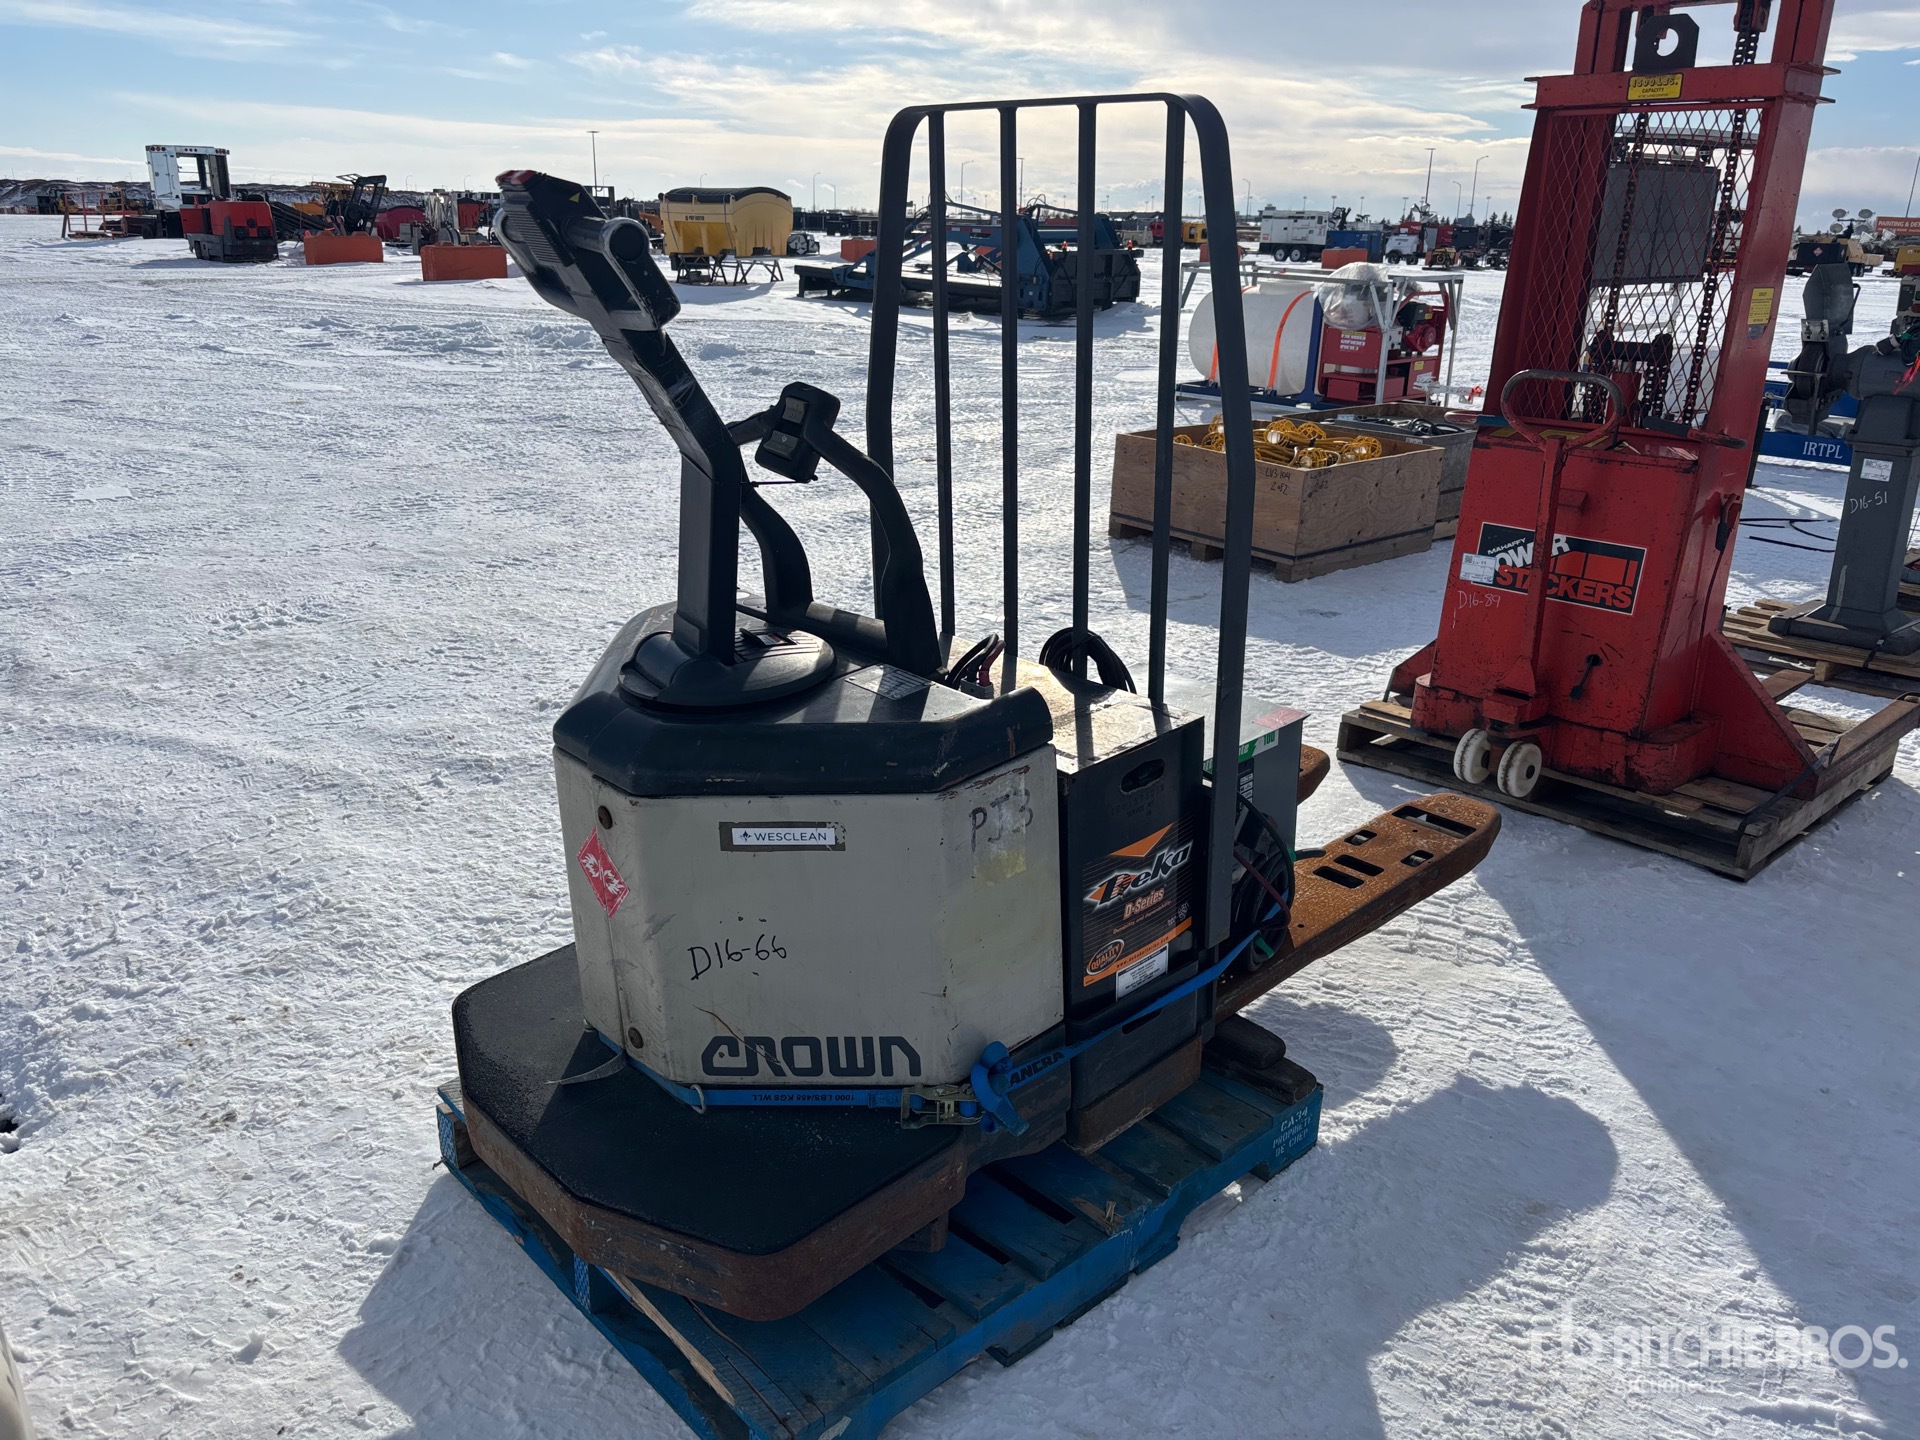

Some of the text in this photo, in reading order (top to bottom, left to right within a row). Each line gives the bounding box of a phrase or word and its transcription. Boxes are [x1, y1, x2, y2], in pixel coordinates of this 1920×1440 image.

[1802, 441, 1843, 459] IRTPL
[1849, 491, 1888, 514] D16-51
[1487, 538, 1526, 555] MAHAFFY
[1457, 590, 1501, 609] D16-89
[753, 831, 827, 842] WESCLEAN
[1093, 842, 1192, 907] Deka
[1122, 887, 1165, 921] D-Series
[687, 933, 788, 981] D16-66
[1091, 943, 1121, 971] QUALITY
[701, 1036, 922, 1077] CROWN
[1008, 1051, 1066, 1088] ANCRA
